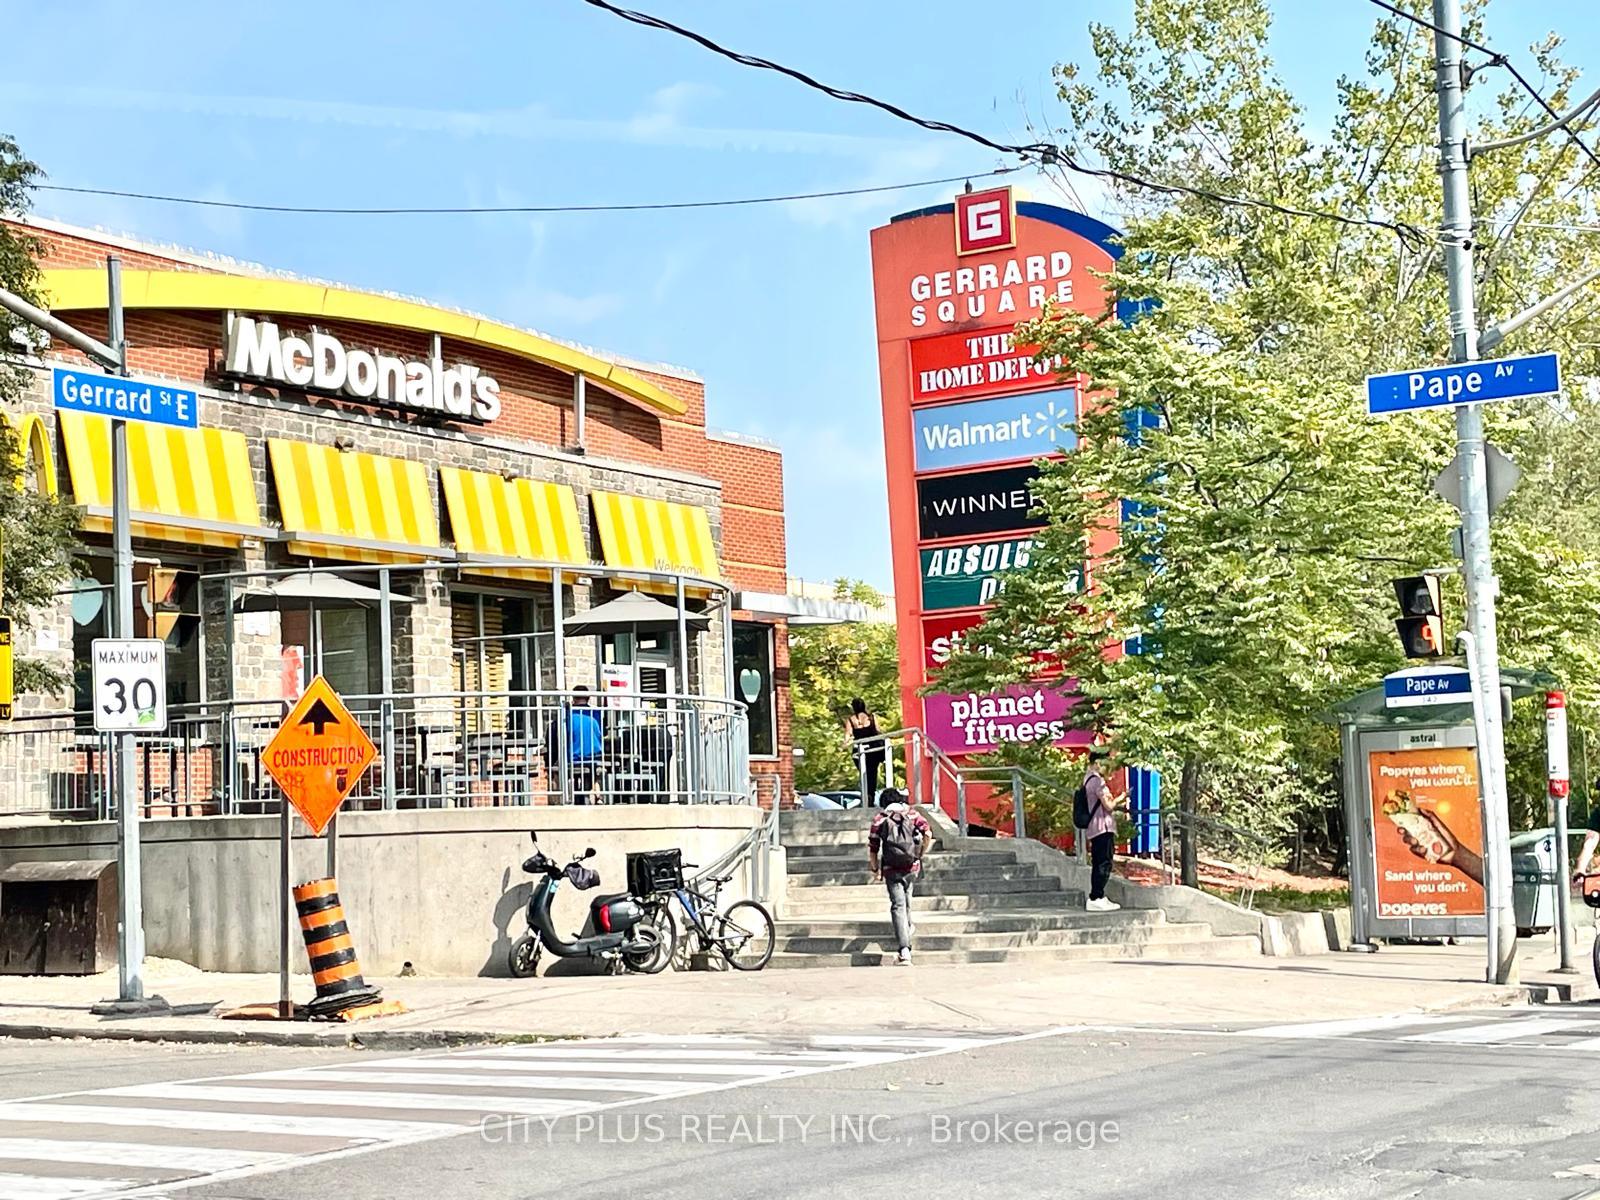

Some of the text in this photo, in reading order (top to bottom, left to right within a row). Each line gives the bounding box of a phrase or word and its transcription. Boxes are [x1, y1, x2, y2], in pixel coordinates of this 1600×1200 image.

[967, 199, 1002, 241] G
[911, 251, 1072, 301] GERRARD
[911, 280, 1074, 327] SQUARE
[966, 332, 1015, 359] THE
[226, 315, 501, 421] McDonald's
[920, 363, 984, 393] HOME
[1408, 363, 1514, 402] Pape Av
[62, 374, 190, 421] Gerrard St E
[923, 413, 1032, 451] Walmart
[653, 557, 703, 577] Welcome
[99, 650, 159, 664] MAXIMUM
[103, 677, 157, 716] 30
[1406, 678, 1450, 694] Pape Av
[951, 690, 1045, 728] planet
[964, 719, 1065, 745] fitness
[1410, 733, 1436, 743] astral
[273, 746, 365, 768] CONSTRUCTION
[1380, 764, 1466, 778] Popeyes where
[1410, 778, 1431, 789] you
[1432, 774, 1463, 787] want
[1384, 869, 1452, 881] Sand where
[1413, 881, 1469, 895] you don't.
